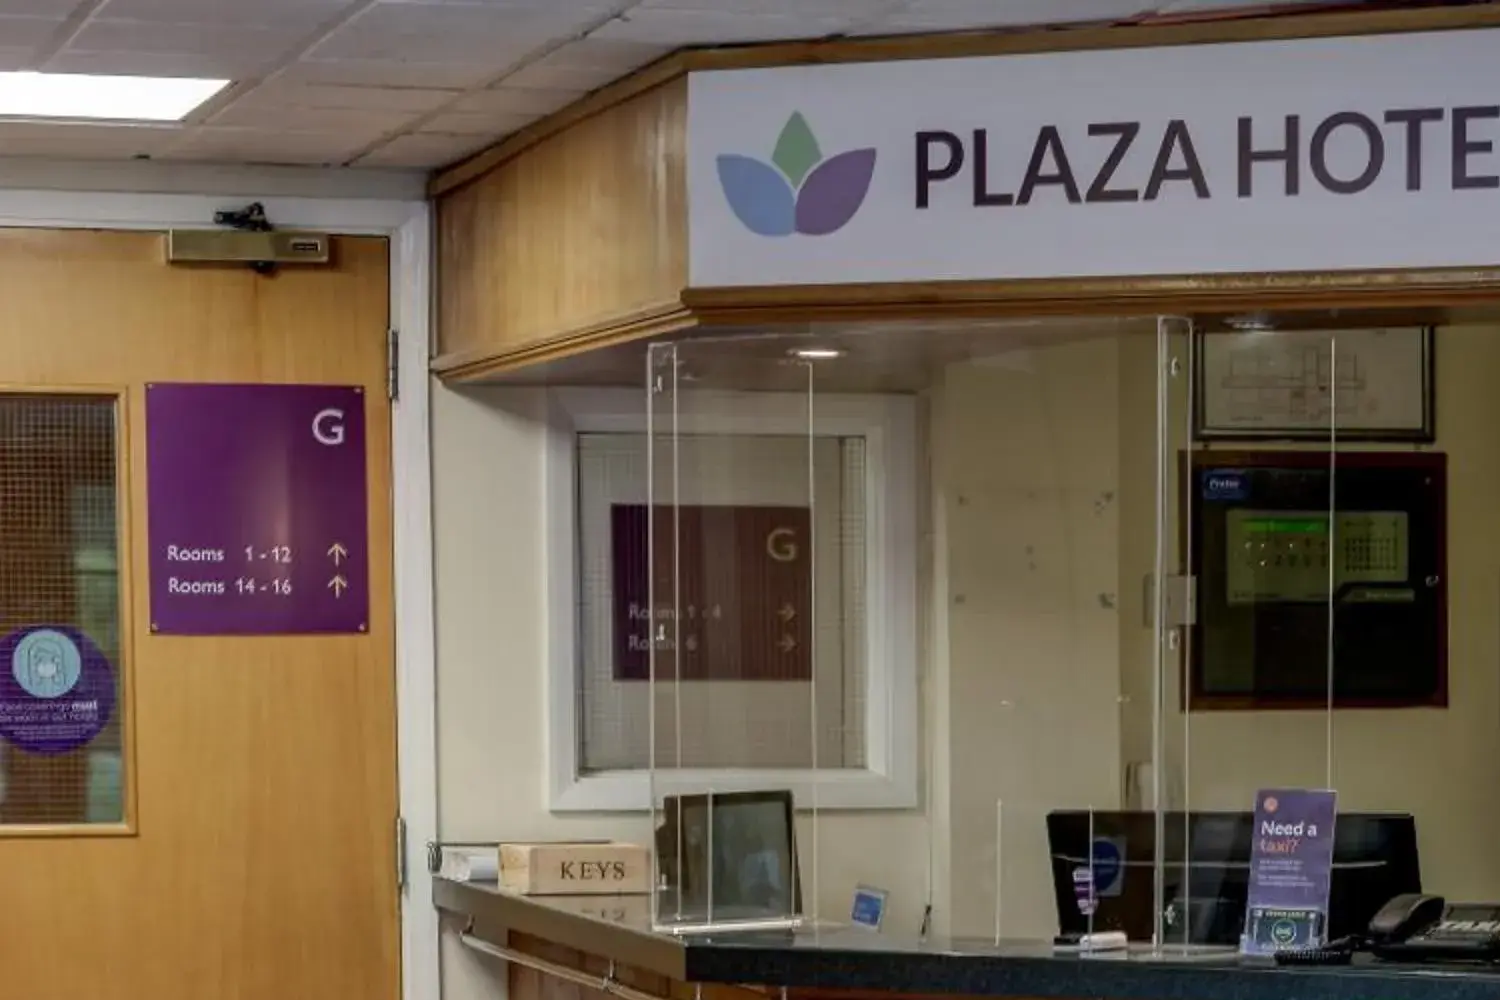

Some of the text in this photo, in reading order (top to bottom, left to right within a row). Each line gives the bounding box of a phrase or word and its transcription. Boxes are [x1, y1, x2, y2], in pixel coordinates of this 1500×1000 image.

[914, 119, 1211, 209] PLAZA
[311, 408, 345, 446] G
[167, 544, 225, 561] Rooms
[245, 547, 254, 561] 1
[271, 547, 292, 563] 12
[766, 527, 799, 562] G
[168, 577, 225, 594] Rooms
[235, 577, 256, 594] 14
[271, 577, 292, 594] 16
[629, 604, 683, 620] Roms
[1261, 819, 1318, 837] Need a
[1259, 838, 1300, 854] taxi?
[560, 860, 626, 881] KEYS
